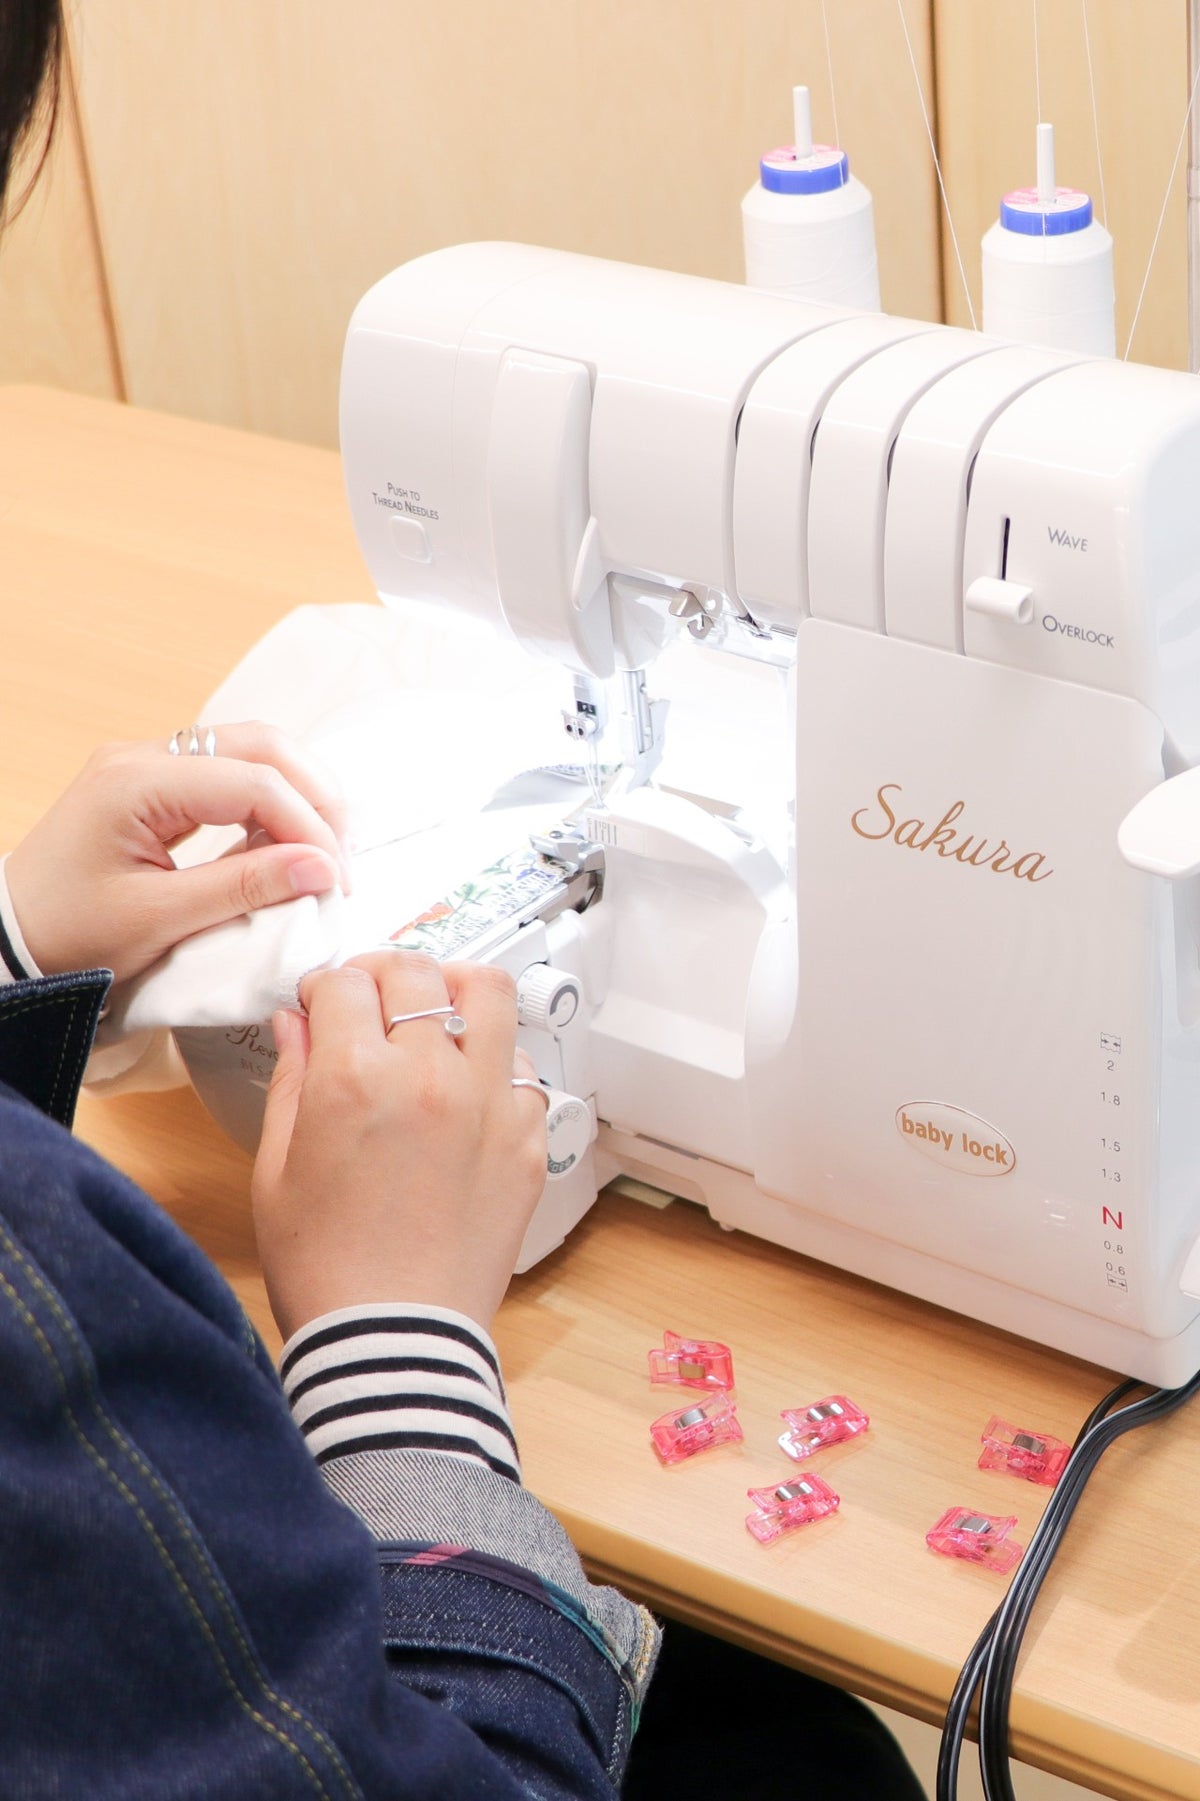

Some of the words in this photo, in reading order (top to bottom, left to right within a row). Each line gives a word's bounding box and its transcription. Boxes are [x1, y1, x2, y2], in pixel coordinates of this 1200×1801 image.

[851, 783, 1054, 883] Sakura
[1107, 1060, 1115, 1072] 2
[1100, 1091, 1121, 1106] 1.8
[901, 1112, 954, 1152] baby
[962, 1132, 1009, 1166] lock
[1100, 1138, 1121, 1152] 1.5
[1101, 1168, 1122, 1183] 1.3
[1102, 1206, 1123, 1230] N
[1103, 1240, 1124, 1255] 0.8
[1105, 1262, 1126, 1276] 0.6
